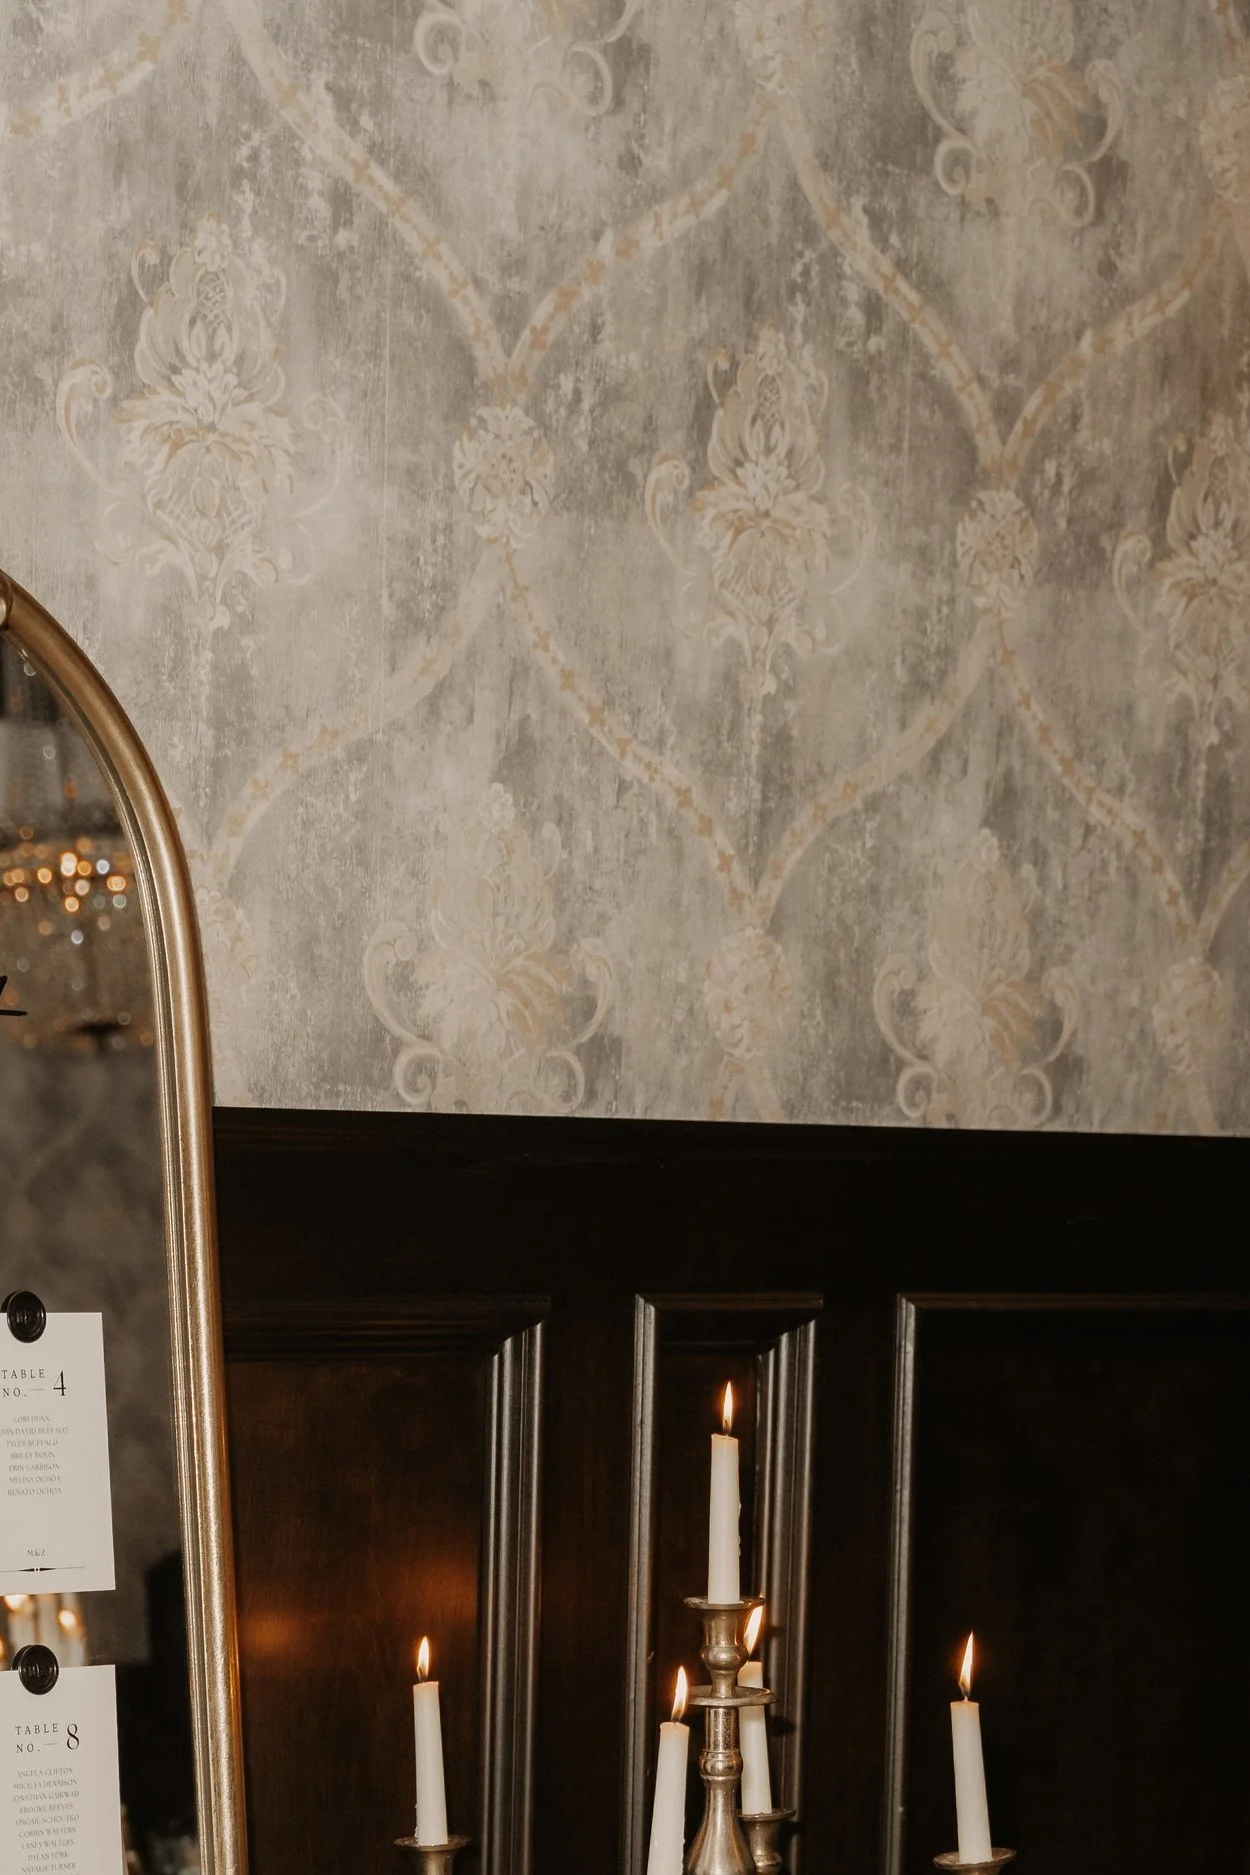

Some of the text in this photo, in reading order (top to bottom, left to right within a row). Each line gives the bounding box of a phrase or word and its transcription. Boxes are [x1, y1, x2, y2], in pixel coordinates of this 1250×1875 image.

[1, 1369, 45, 1379] TABLE
[53, 1370, 66, 1396] 4
[15, 1723, 58, 1735] TABLE
[67, 1724, 79, 1750] 8
